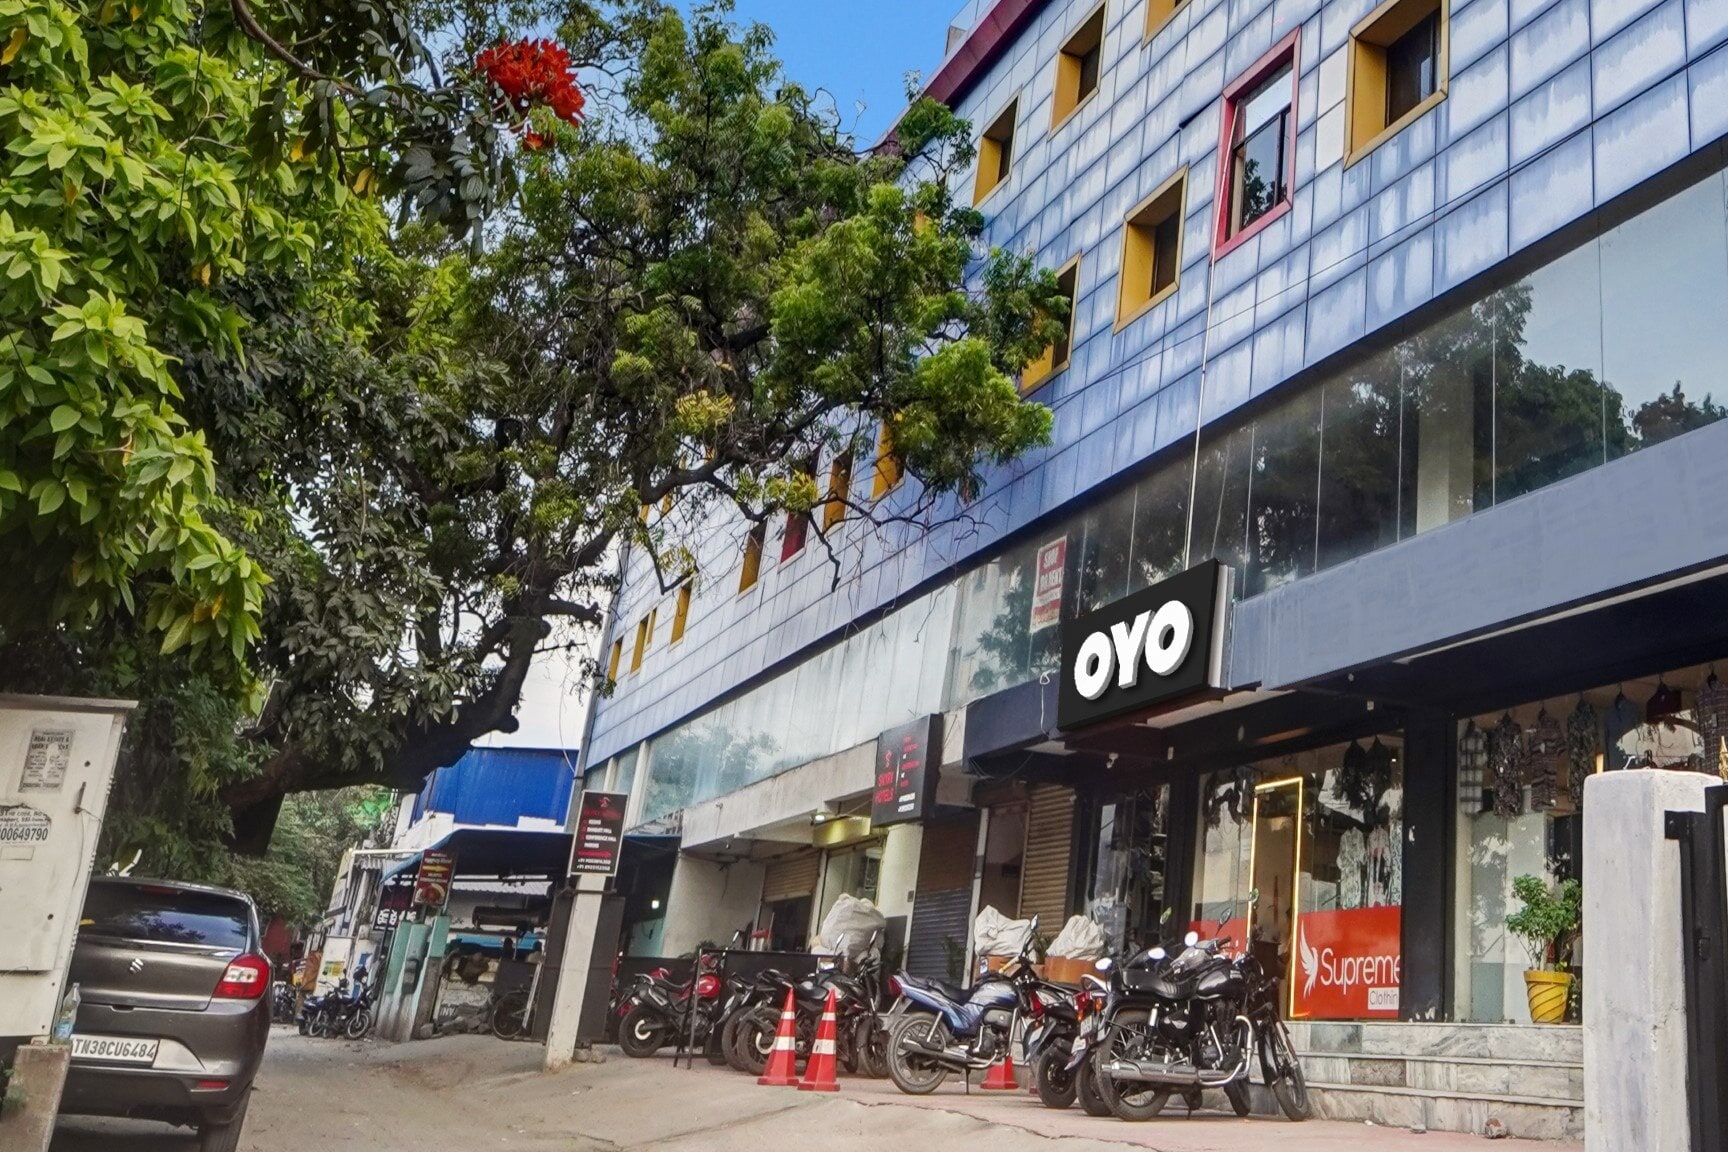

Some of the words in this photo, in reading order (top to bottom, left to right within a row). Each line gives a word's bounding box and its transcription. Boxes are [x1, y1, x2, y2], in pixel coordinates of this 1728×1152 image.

[1074, 600, 1194, 700] OYO
[0, 828, 49, 841] 00649790
[1320, 947, 1400, 995] Supreme
[74, 1038, 156, 1058] TN38CU6484
